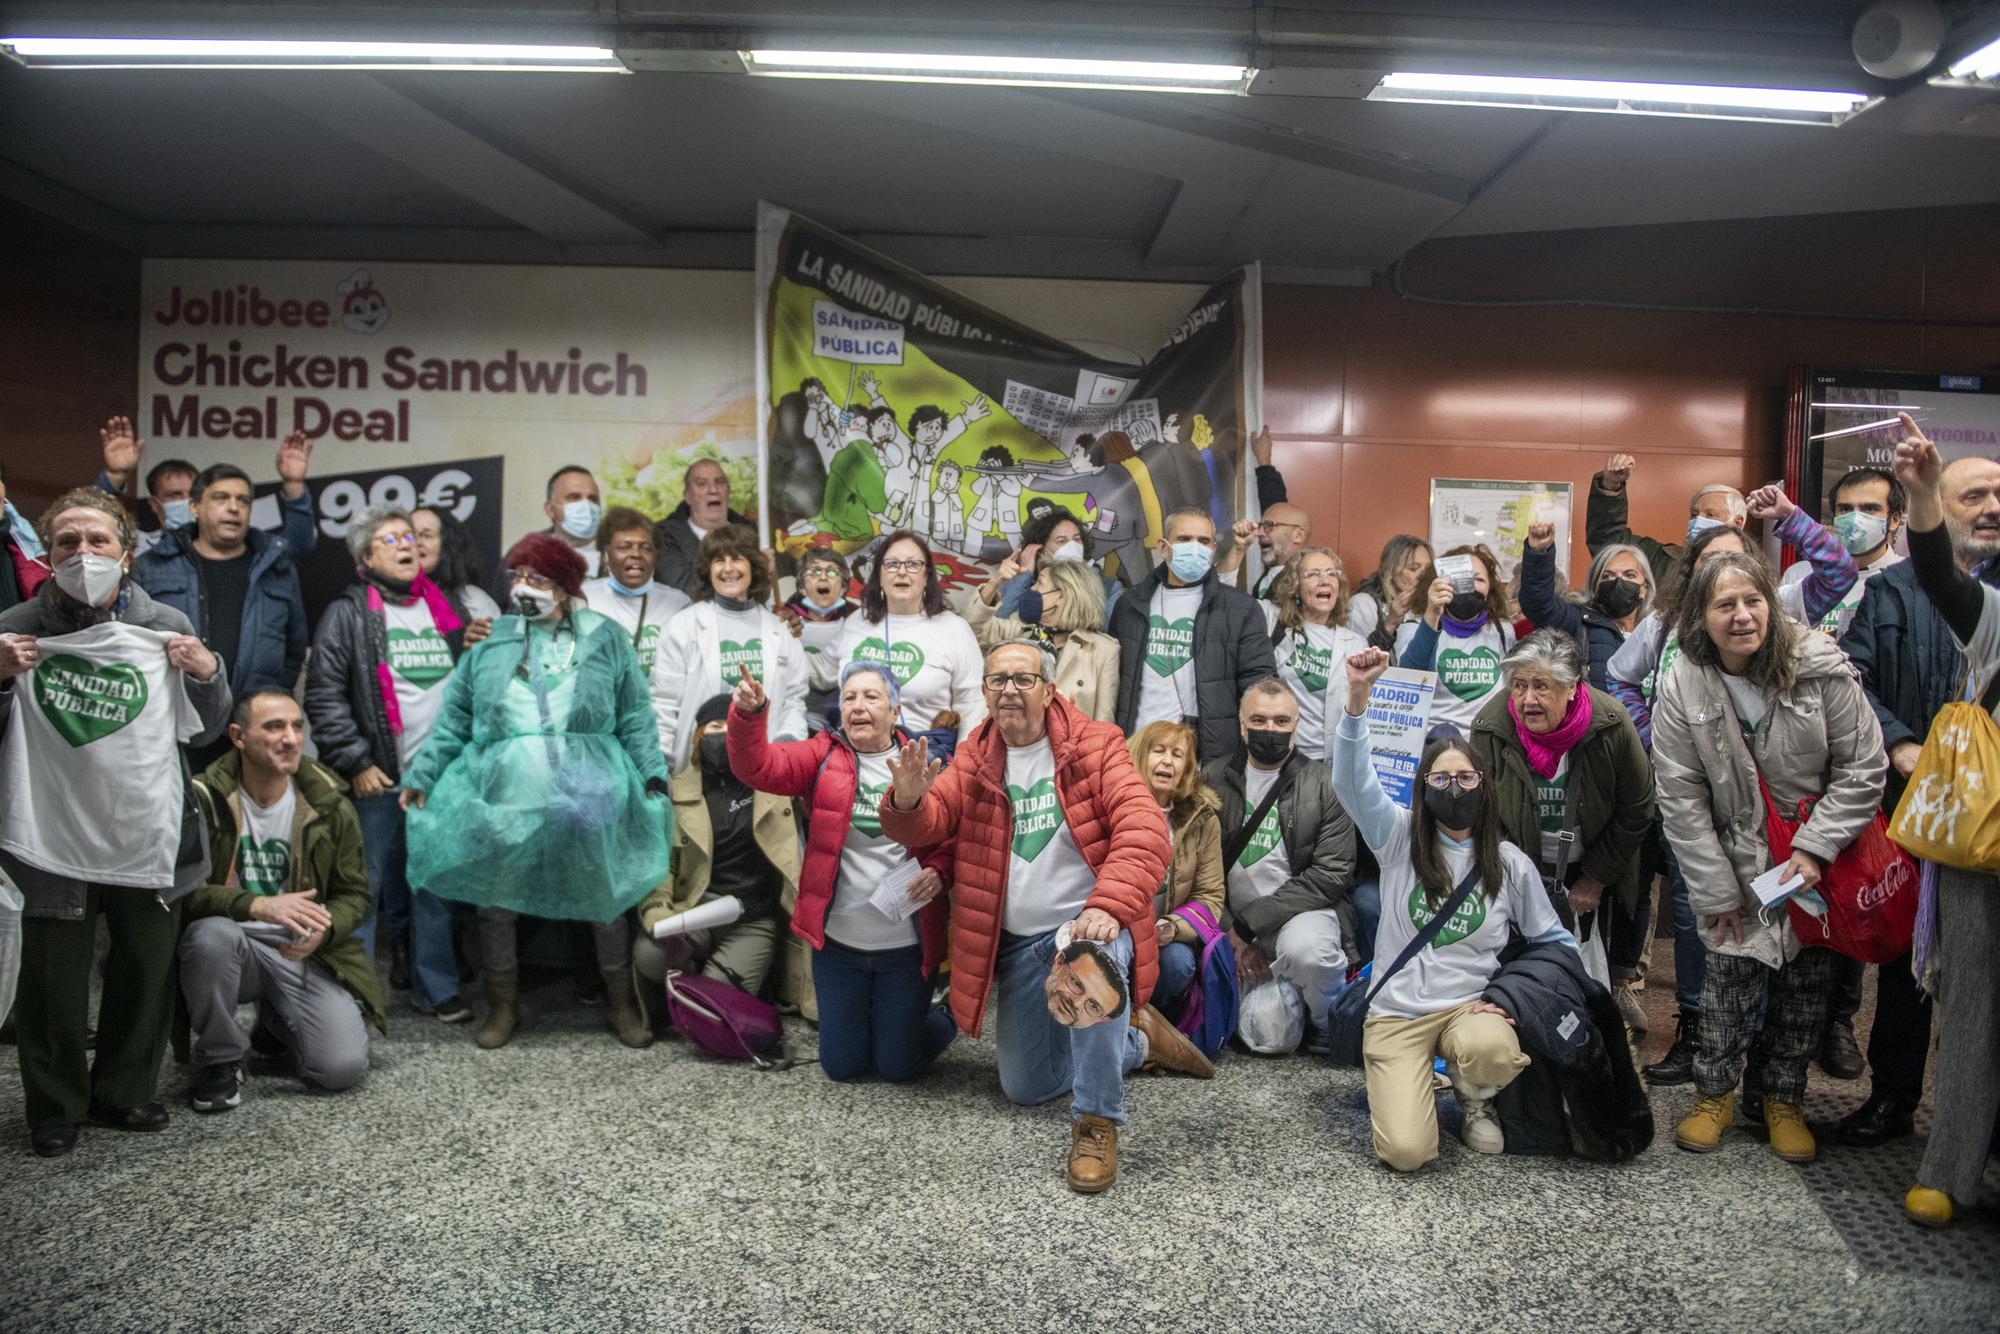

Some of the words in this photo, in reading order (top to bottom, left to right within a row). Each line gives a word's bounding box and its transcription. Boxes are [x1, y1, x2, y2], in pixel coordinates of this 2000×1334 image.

[797, 250, 824, 281] LA
[826, 263, 911, 321] SANIDAD
[155, 286, 330, 328] Jollibee
[821, 335, 899, 356] PÚBLICA
[153, 340, 369, 389] Chicken
[382, 346, 648, 396] Sandwich
[1948, 377, 1973, 388] global
[151, 394, 278, 440] Meal
[294, 398, 411, 443] Deal
[1148, 627, 1193, 643] ANIDAD
[1444, 668, 1495, 685] PÚBLICA
[1446, 658, 1495, 670] SANIDAD
[47, 668, 135, 700] SANIDAD
[42, 687, 128, 723] PÚBLICA
[1389, 711, 1424, 729] PÚBLICA
